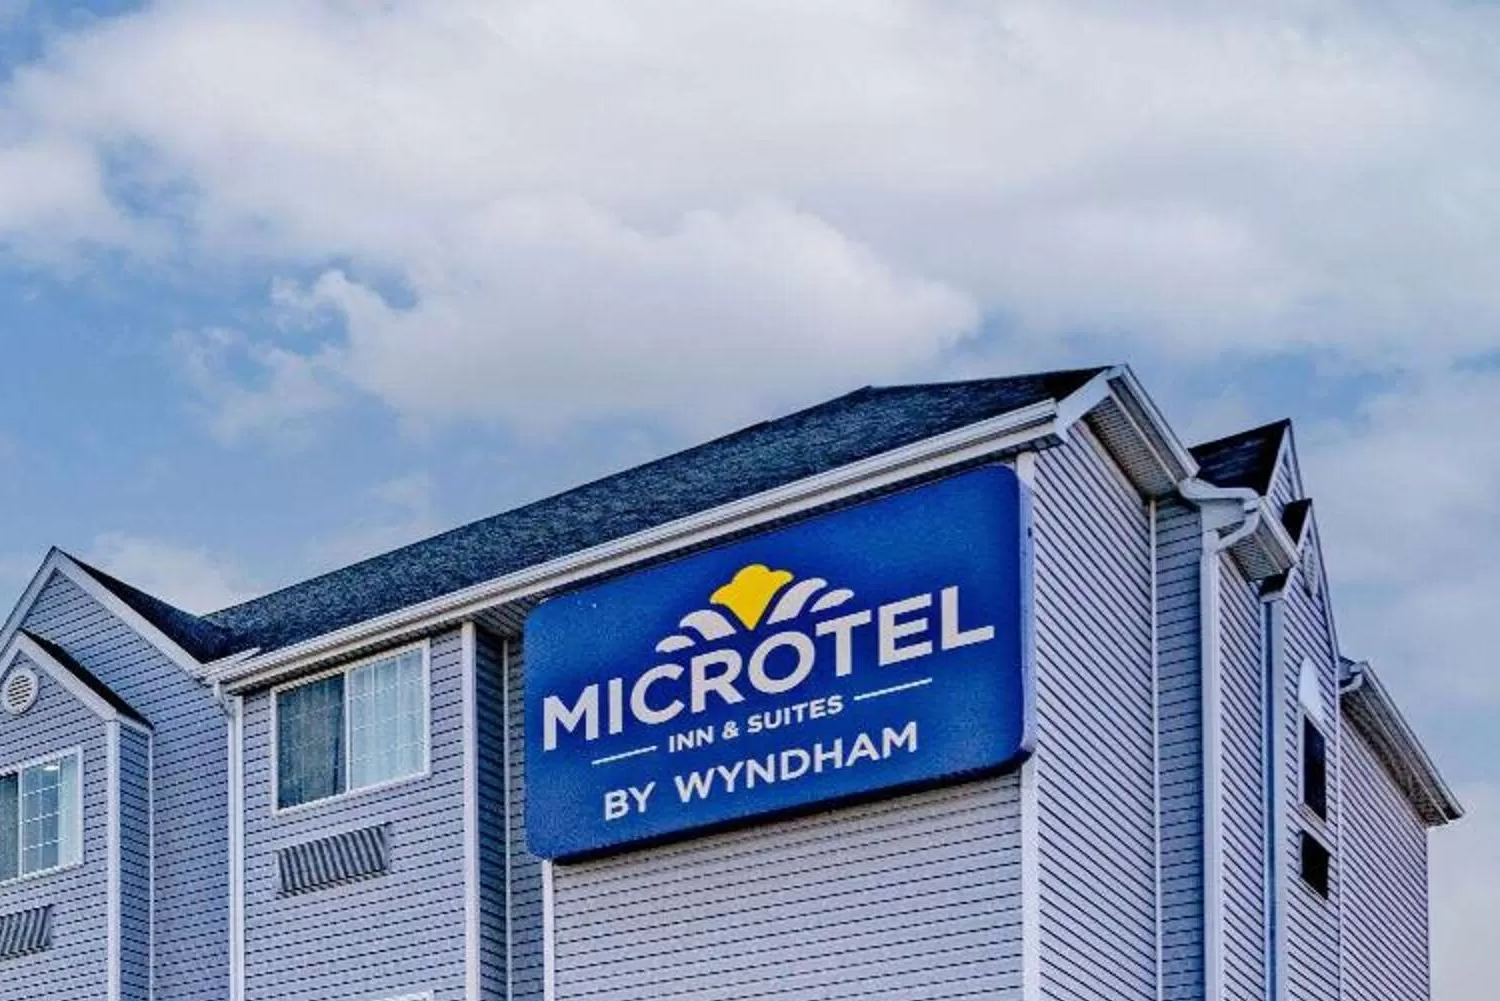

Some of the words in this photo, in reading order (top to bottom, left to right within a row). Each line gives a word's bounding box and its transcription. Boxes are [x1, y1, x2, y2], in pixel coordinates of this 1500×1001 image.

[542, 585, 996, 752] MICROTEL
[604, 782, 657, 822] BY
[674, 721, 919, 803] WYNDHAM
[668, 725, 715, 753] INN
[722, 721, 740, 741] &
[747, 695, 844, 733] SUITES
